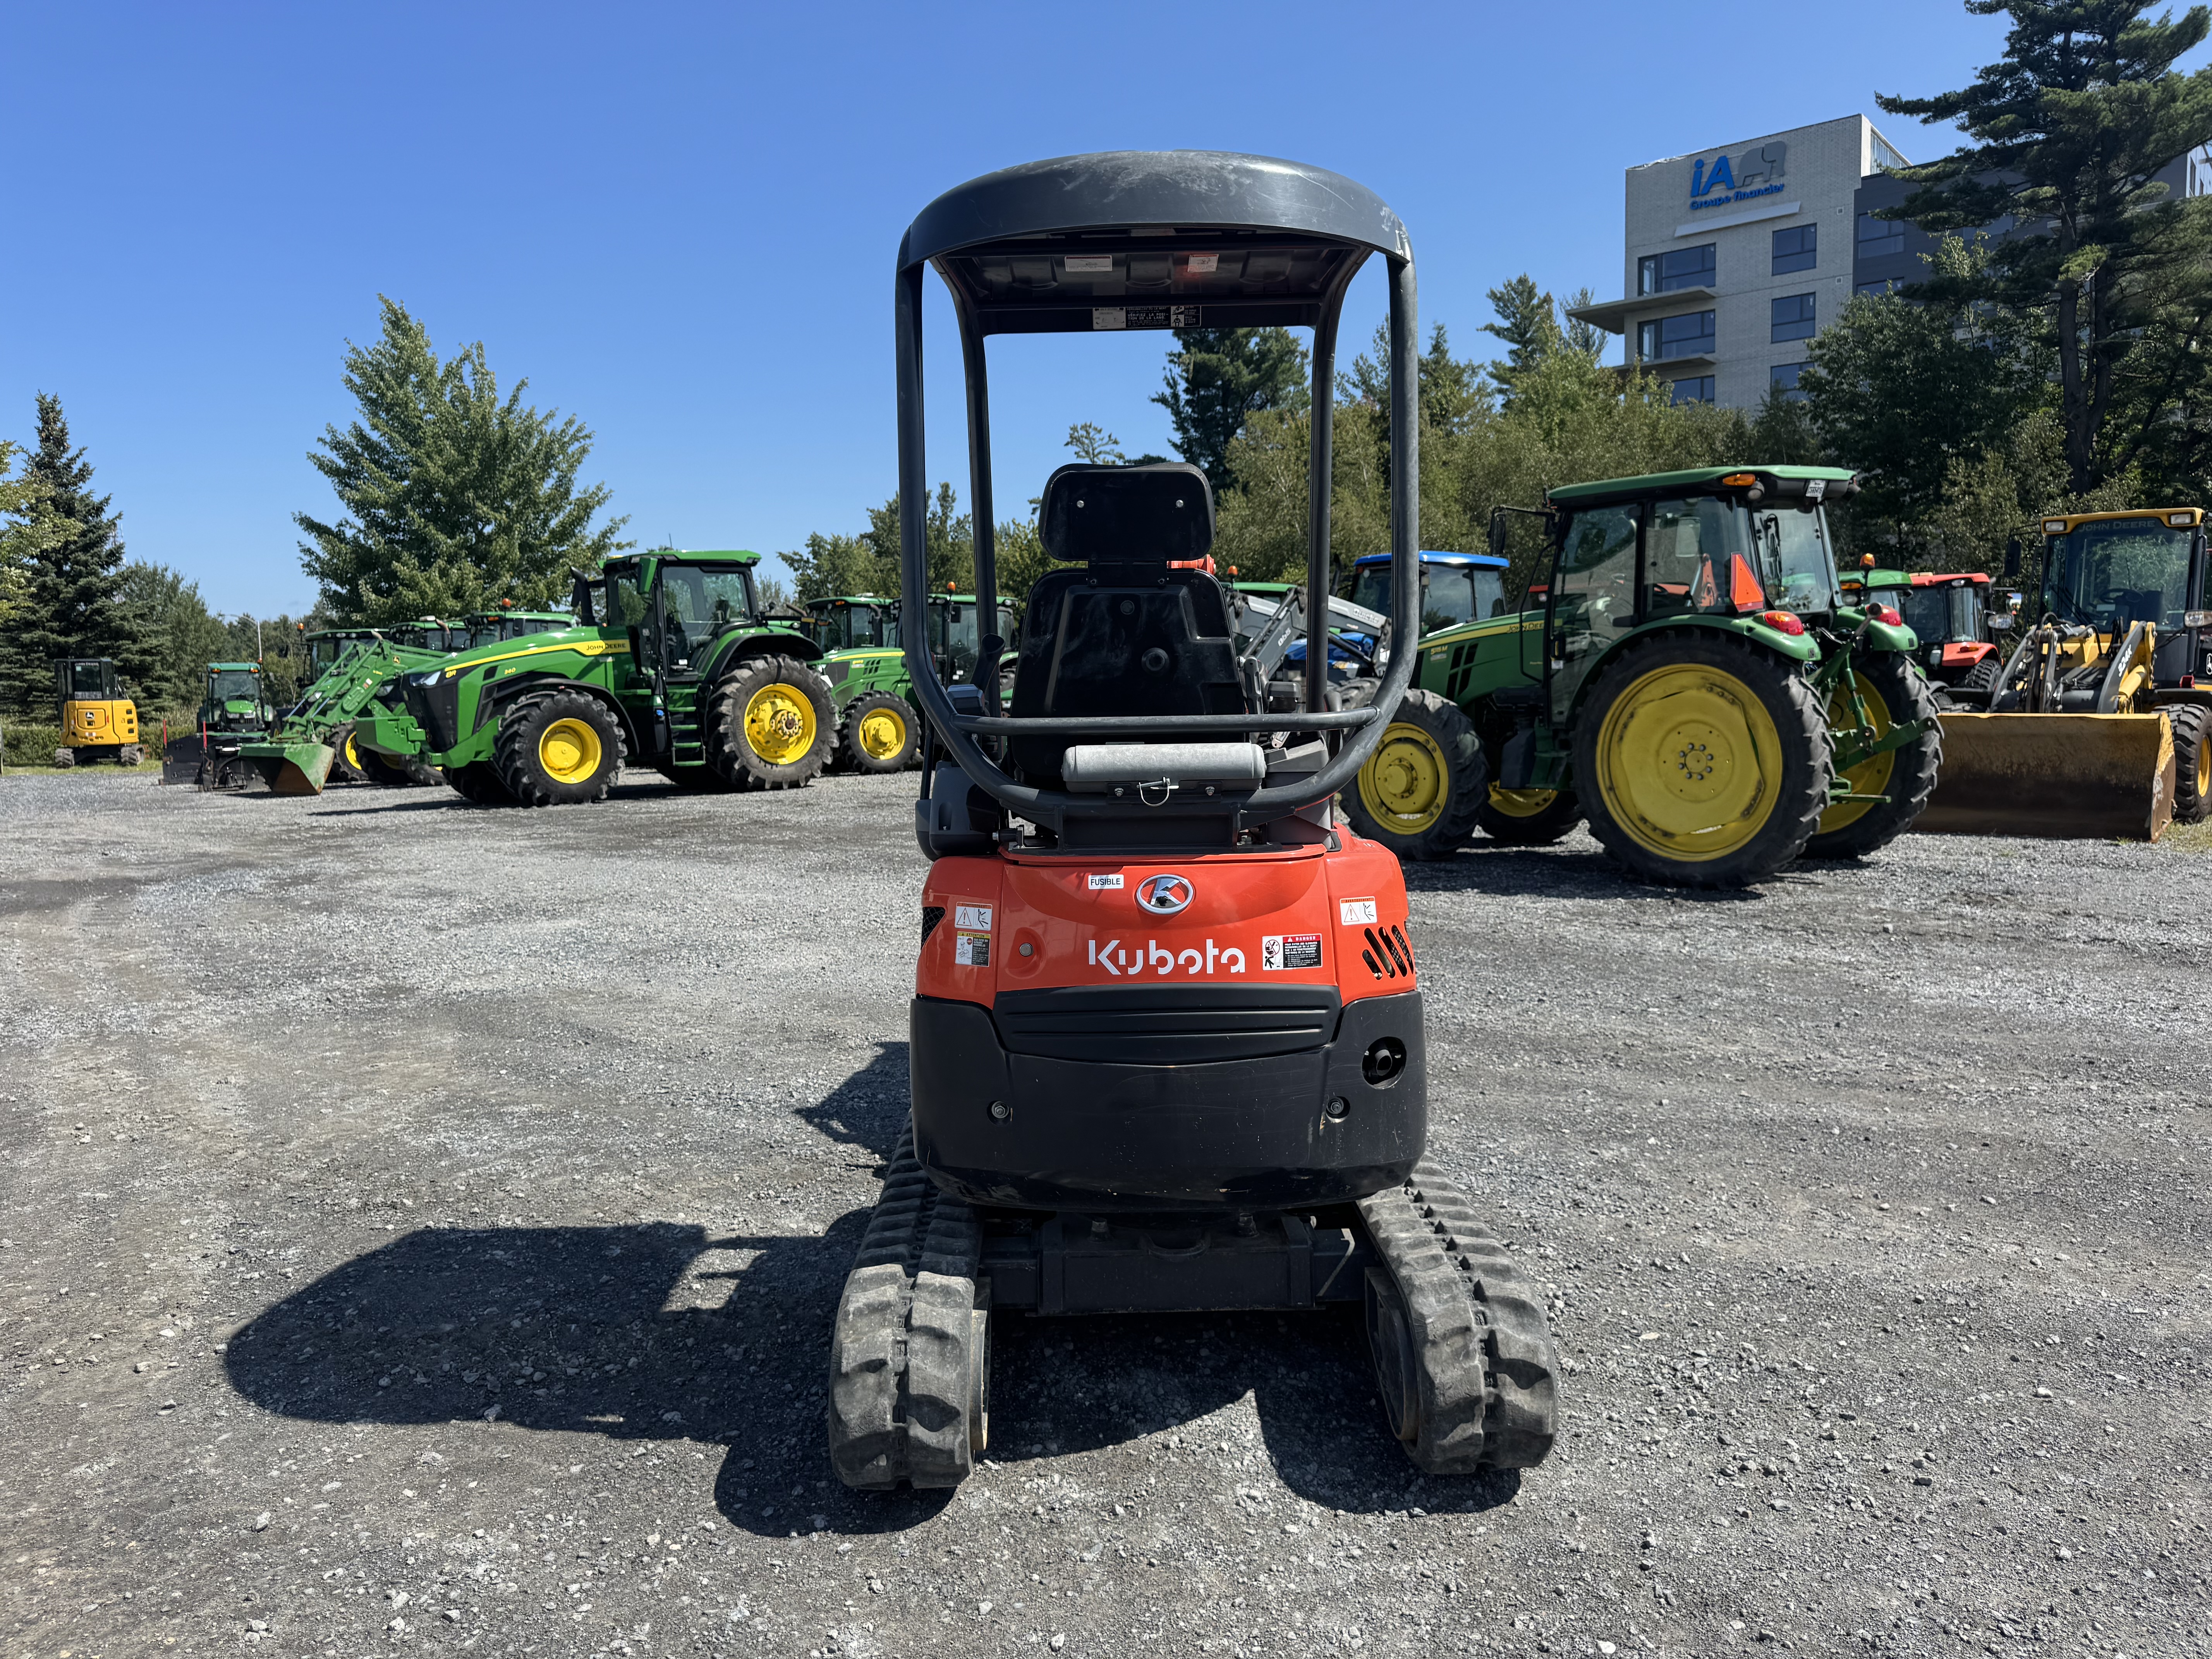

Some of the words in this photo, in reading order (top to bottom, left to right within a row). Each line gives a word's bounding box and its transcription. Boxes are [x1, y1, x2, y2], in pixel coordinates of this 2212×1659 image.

[1690, 195, 1731, 210] Groupe
[1734, 183, 1785, 201] financier
[2079, 523, 2110, 532] JOHN
[2112, 520, 2155, 529] DEERE
[1528, 622, 1544, 631] DEE
[1091, 878, 1121, 886] FUSIBLE
[1088, 939, 1245, 975] Kubota
